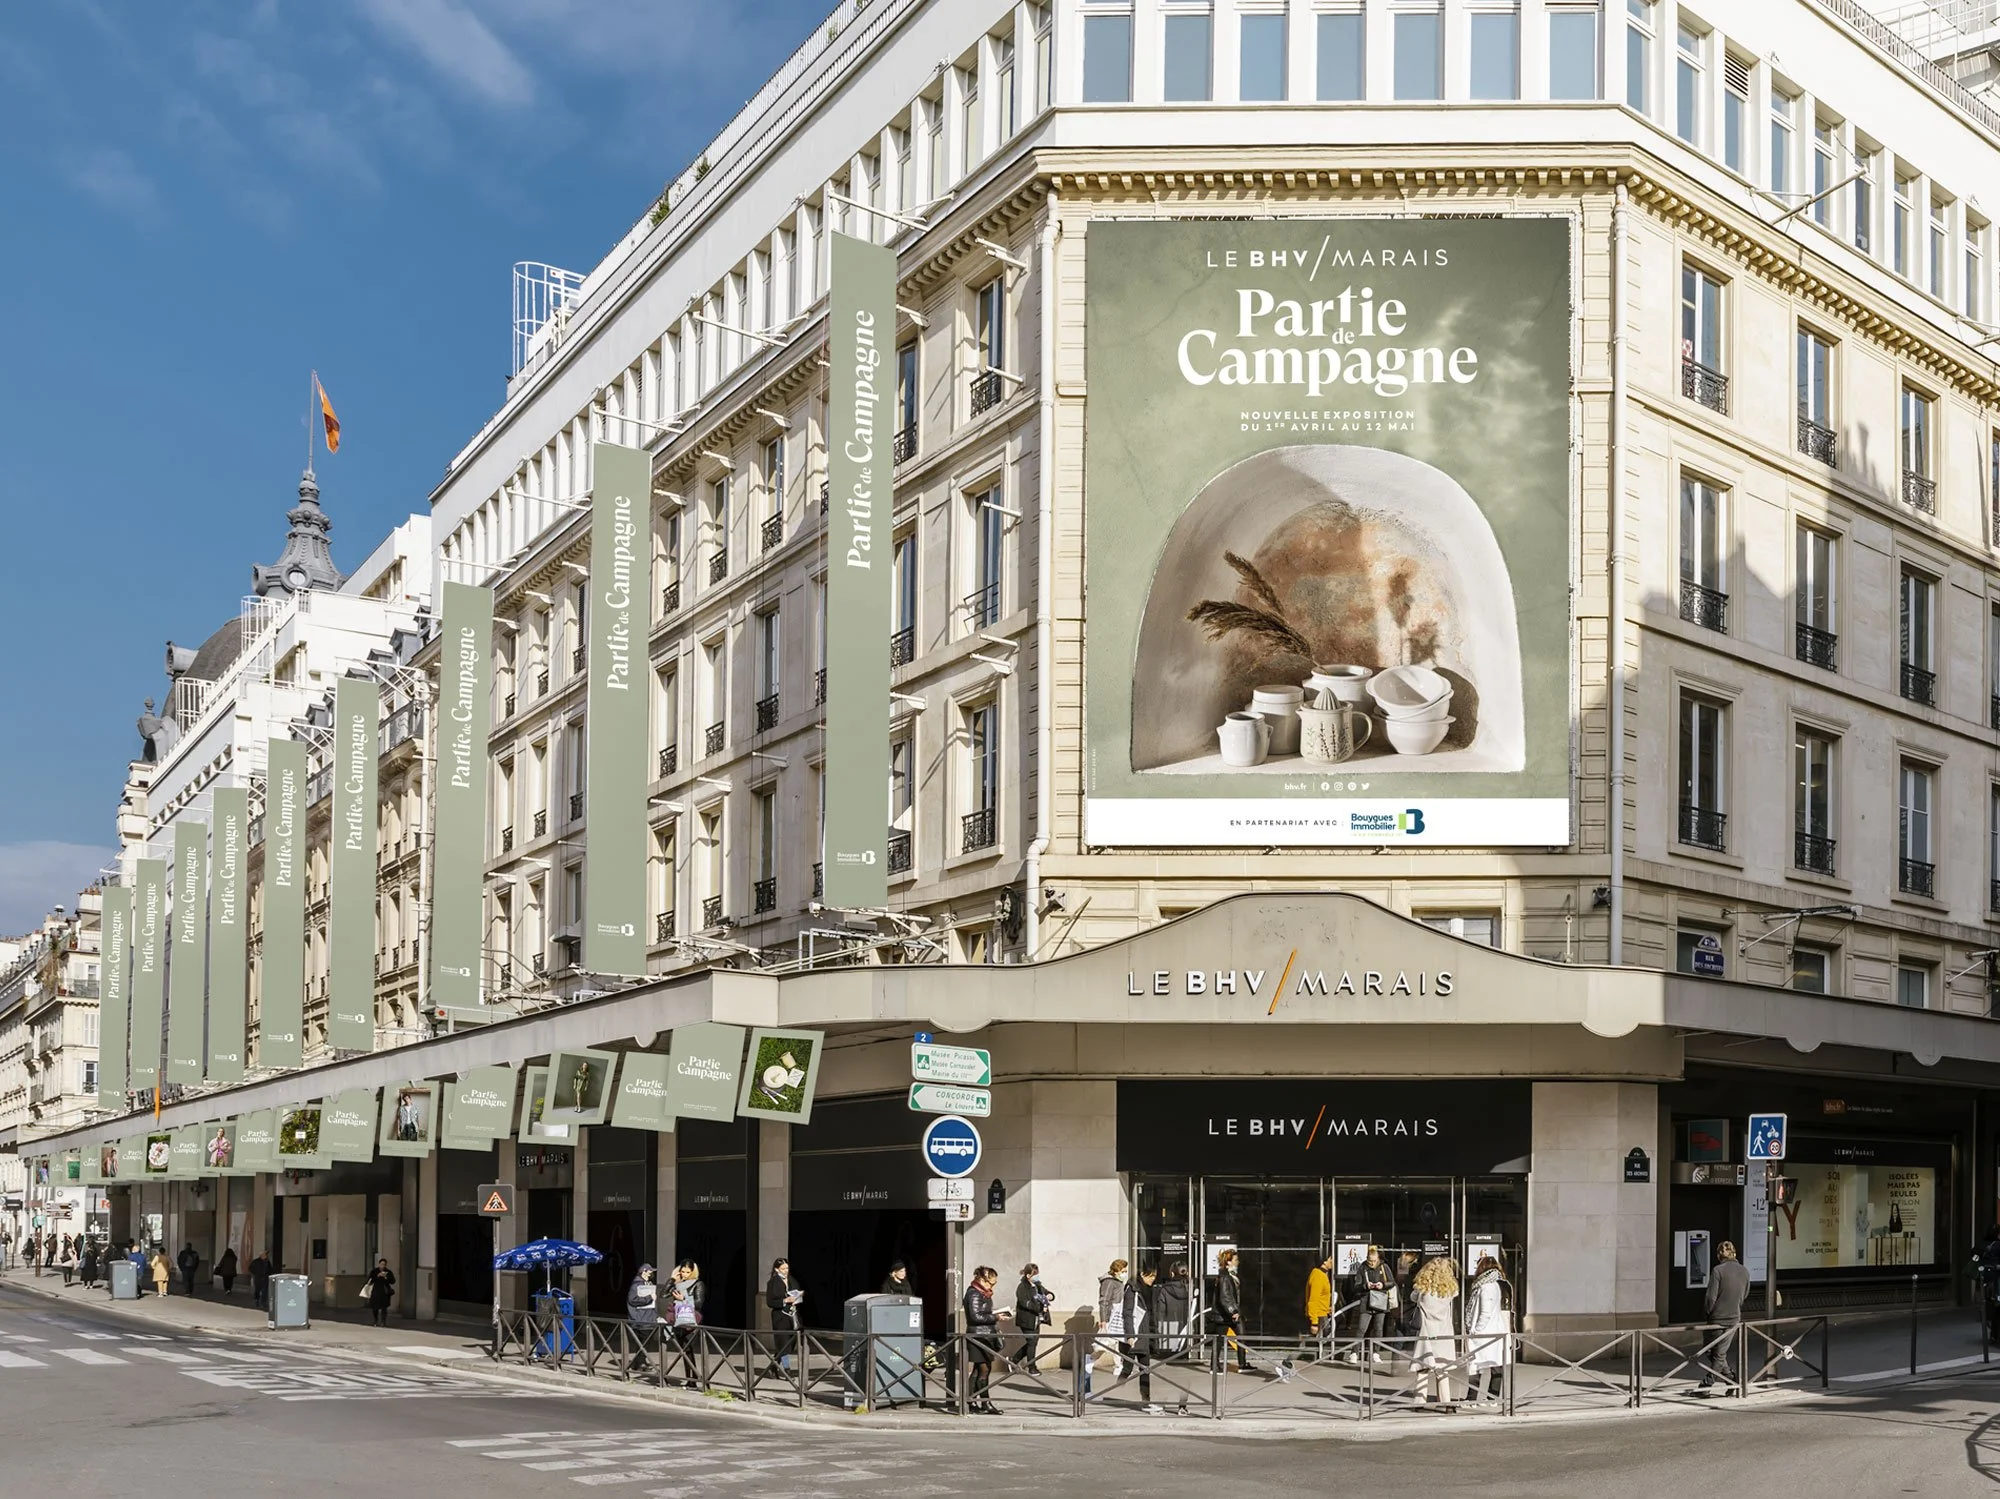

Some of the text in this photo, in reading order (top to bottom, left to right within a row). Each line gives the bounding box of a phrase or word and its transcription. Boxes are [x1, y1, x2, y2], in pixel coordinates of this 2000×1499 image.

[1206, 250, 1238, 268] LE
[1235, 284, 1407, 338] Partie
[1331, 327, 1355, 345] de
[1177, 329, 1478, 398] Campagne
[1240, 410, 1415, 420] NOUVELLE EXPOSITION
[1240, 423, 1260, 431] DU
[1290, 423, 1335, 431] AVRIL
[1341, 423, 1360, 431] AU
[1366, 423, 1382, 431] 12
[1388, 422, 1414, 430] MAI
[845, 310, 881, 570] Partie de Campagne
[605, 495, 637, 691] Partie de Campagne
[450, 626, 479, 723] Campagne
[344, 714, 369, 794] Campagne
[451, 733, 472, 789] Partie
[1284, 783, 1307, 791] bhv.fr
[275, 768, 298, 838] Campagne
[345, 803, 363, 851] Partie
[1351, 813, 1394, 823] Bouygues
[1351, 822, 1396, 831] Immobilier
[219, 814, 240, 880] Campagne
[180, 846, 199, 904] Campagne
[276, 844, 292, 887] Partie
[141, 882, 159, 936] Campagne
[220, 886, 235, 925] Partie
[107, 910, 125, 964] Campagne
[181, 912, 195, 945] Partie
[141, 941, 154, 973] Partie
[108, 968, 120, 999] Partie
[1127, 971, 1170, 995] LE
[920, 1033, 927, 1043] 2
[677, 1062, 732, 1081] Campagne
[689, 1055, 721, 1070] Partie
[471, 1089, 498, 1099] Partie
[625, 1083, 668, 1097] Campagn
[635, 1078, 663, 1089] Partie
[935, 1091, 975, 1101] CONCORDE
[461, 1094, 508, 1108] Campagne
[327, 1115, 369, 1128] Campagne
[1208, 1119, 1238, 1136] LE
